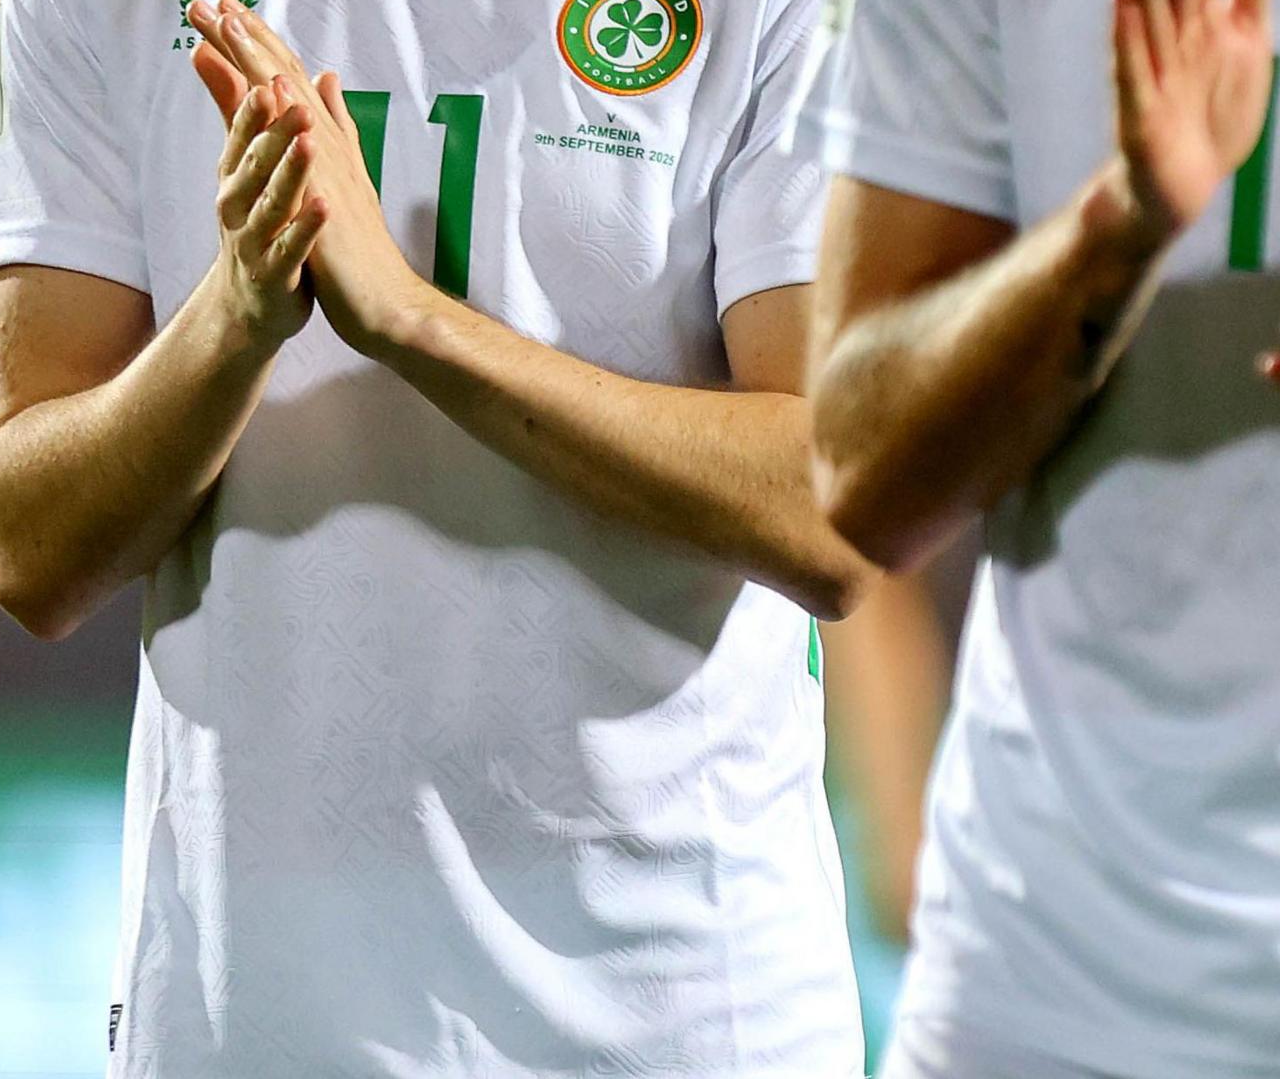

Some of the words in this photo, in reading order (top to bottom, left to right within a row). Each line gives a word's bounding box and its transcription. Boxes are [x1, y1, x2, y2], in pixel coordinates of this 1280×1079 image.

[583, 62, 666, 86] FOOTBALL
[576, 123, 641, 143] ARMENIA
[534, 133, 555, 146] 9th
[559, 136, 645, 160] SEPTEMBER
[649, 150, 675, 166] 2025
